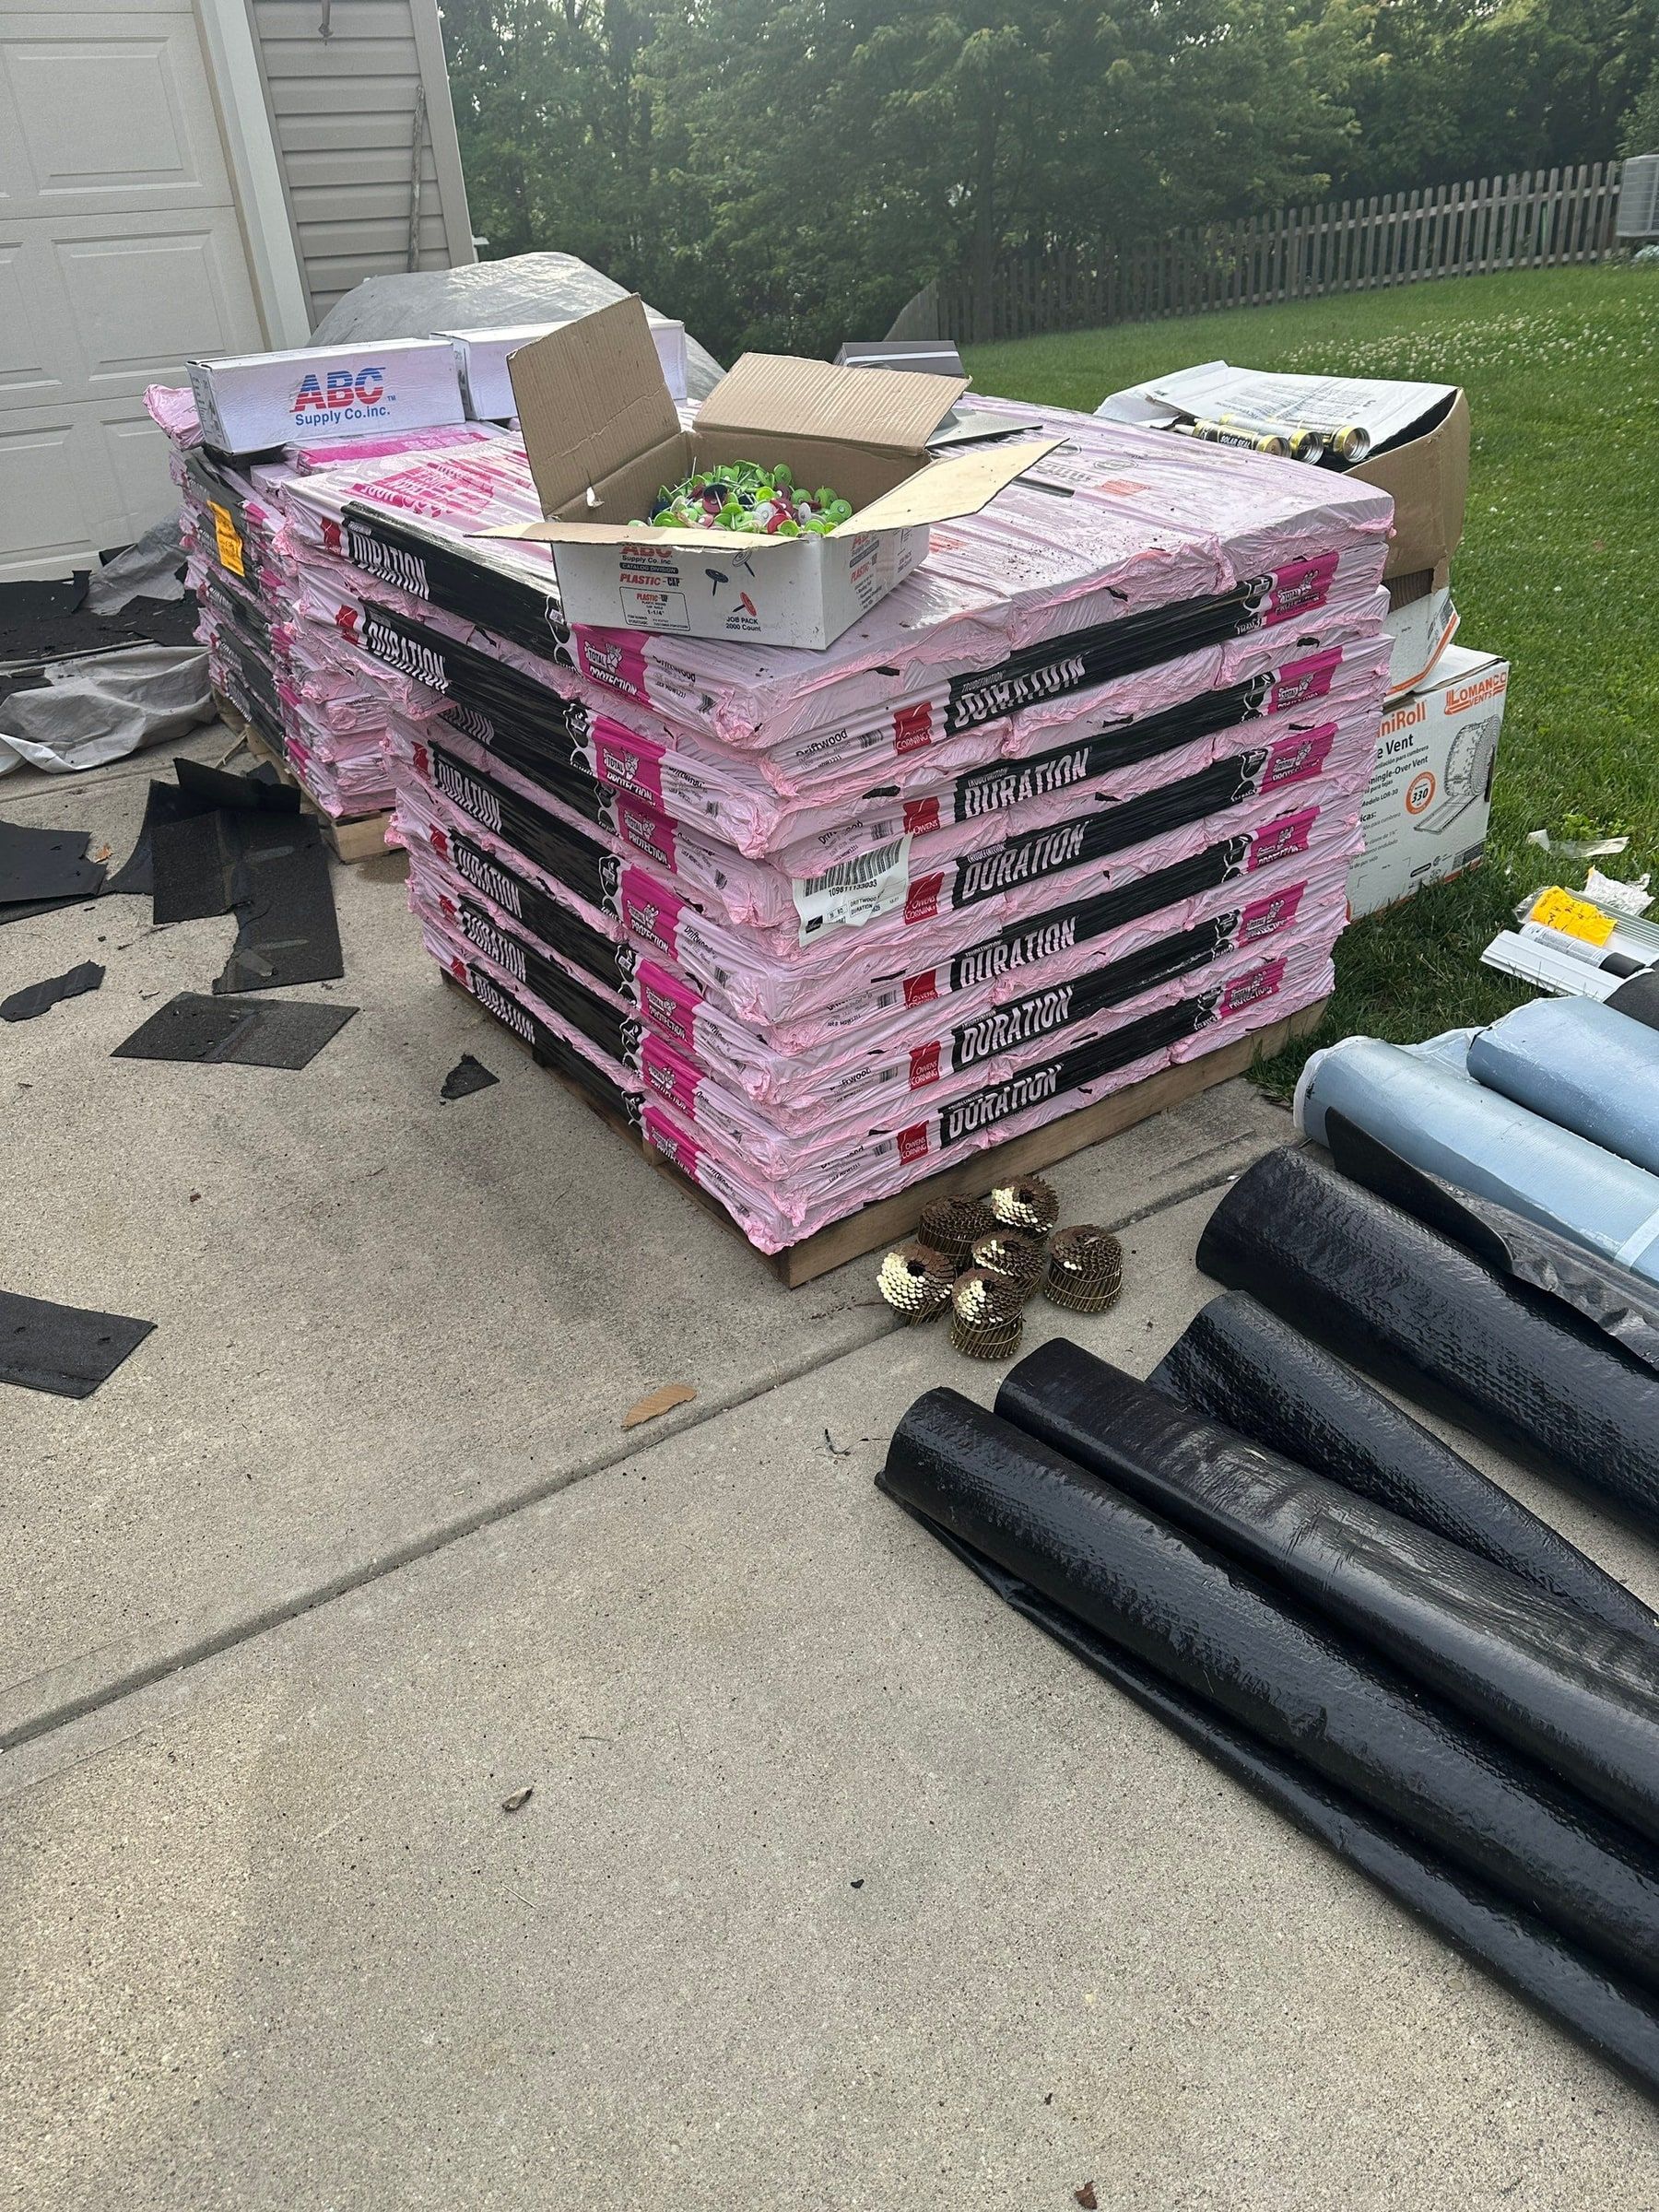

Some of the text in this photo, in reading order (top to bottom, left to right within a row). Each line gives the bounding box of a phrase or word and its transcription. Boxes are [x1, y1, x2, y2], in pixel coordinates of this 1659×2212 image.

[289, 367, 385, 413] ABC
[295, 410, 341, 427] Supply
[1220, 434, 1251, 449] SOLAR SEAL
[352, 532, 429, 601] DURATION
[622, 555, 646, 563] Supply
[650, 565, 677, 573] DIVISION
[725, 622, 741, 630] 2000
[368, 621, 449, 694] DURATION
[588, 649, 606, 666] TOTAL
[590, 665, 638, 695] PROTECTION
[1447, 672, 1507, 706] LOMANCO
[1469, 689, 1493, 706] VENTS
[1377, 702, 1427, 738] niRoll
[795, 728, 848, 757] Driftwood
[897, 732, 929, 750] CORNING
[1385, 734, 1414, 756] Vent
[606, 757, 625, 774] TOTAL
[1412, 756, 1429, 768] Vent
[965, 747, 1088, 818] DURATION
[437, 762, 502, 834] DURATION
[1411, 787, 1430, 804] 330
[913, 819, 938, 835] OWENS
[629, 832, 668, 865] PROTECTION
[962, 820, 1089, 900] DURATION
[457, 844, 523, 919] DURATION
[463, 912, 526, 983] DURATION
[631, 918, 669, 953] PROTECTION
[960, 916, 1077, 988] DURATION
[961, 985, 1074, 1064] DURATION
[911, 1069, 938, 1087] CORNING
[916, 1061, 937, 1075] OWENS
[949, 1064, 1063, 1139] DURATION
[902, 1145, 927, 1159] CORNING
[905, 1136, 926, 1150] OWENS
